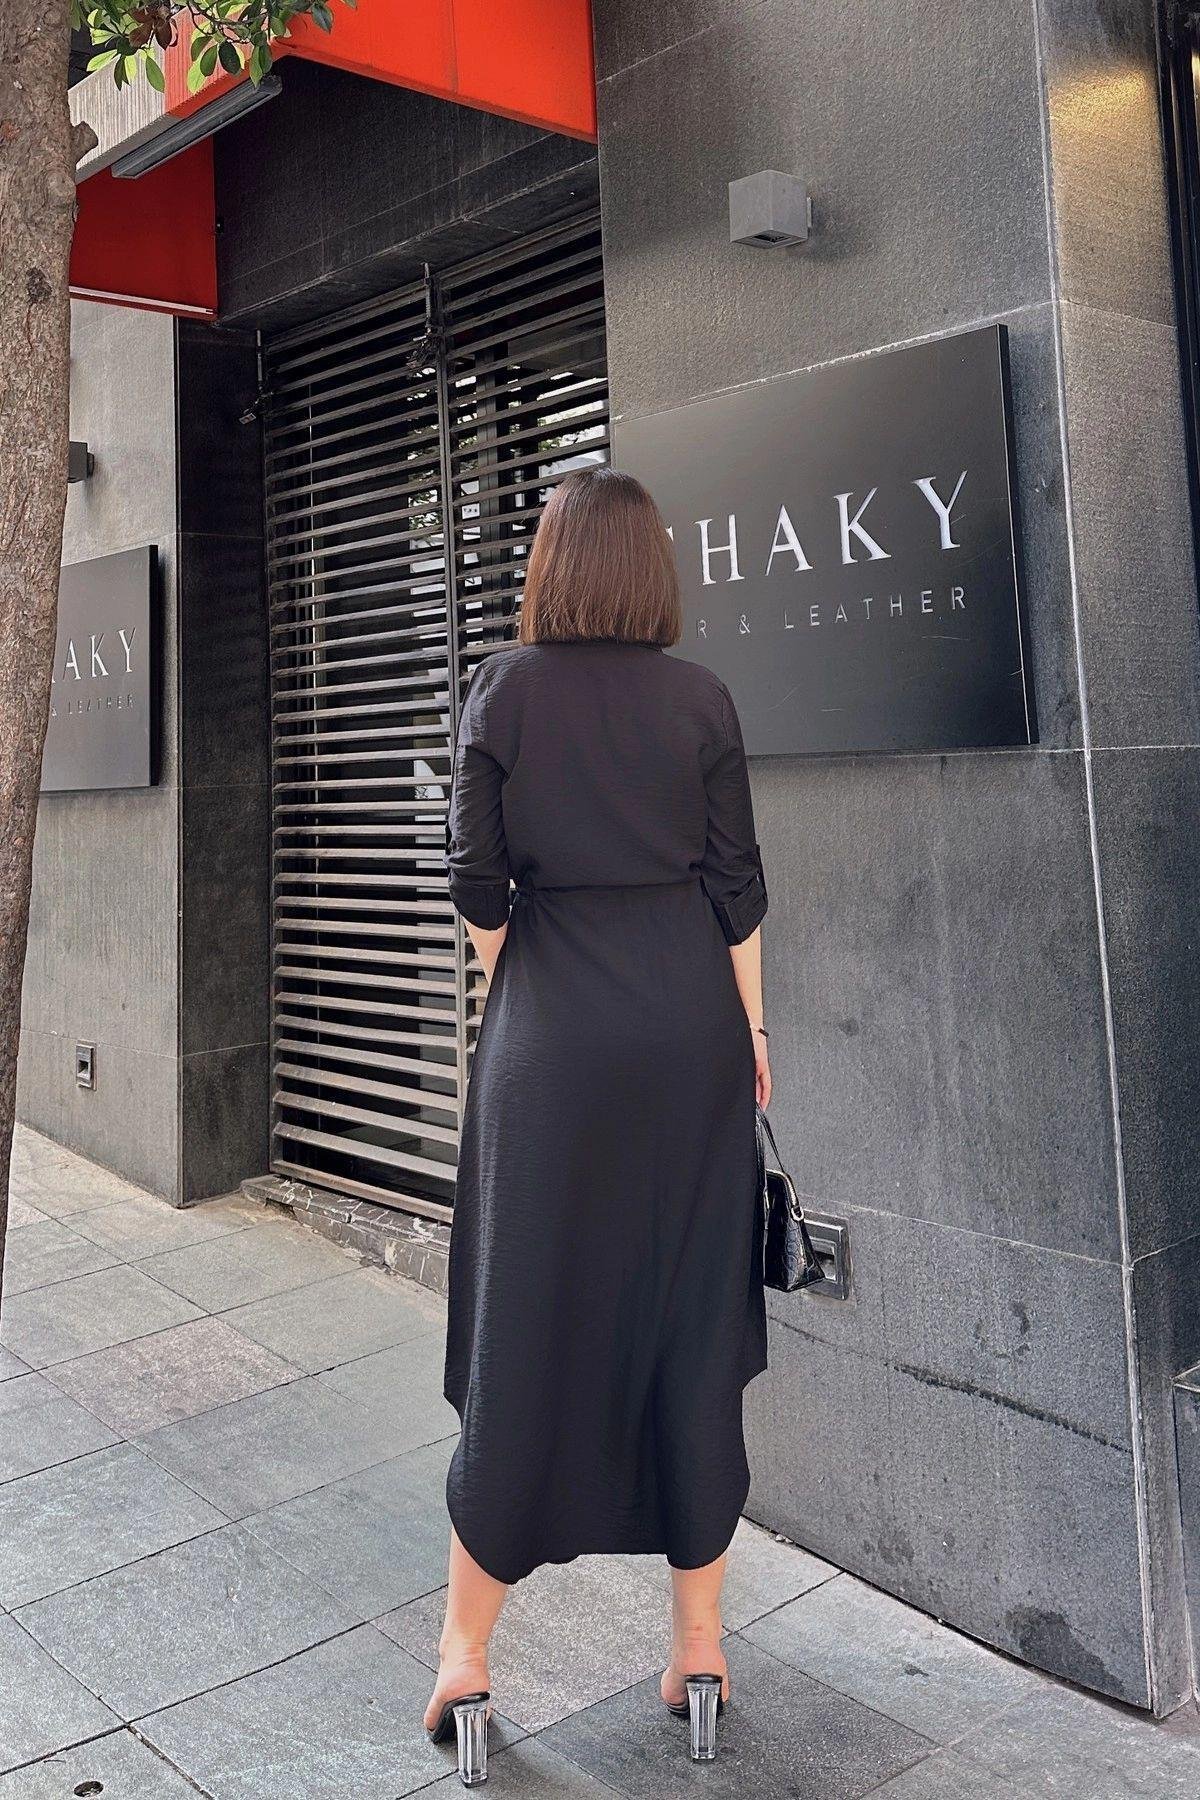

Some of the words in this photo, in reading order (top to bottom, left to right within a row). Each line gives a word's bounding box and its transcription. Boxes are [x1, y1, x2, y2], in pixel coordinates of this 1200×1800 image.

[665, 470, 968, 585] HAKY
[739, 614, 750, 634] &
[783, 586, 966, 629] LEATHER
[52, 627, 136, 683] AKY
[68, 694, 133, 715] LEATHER
